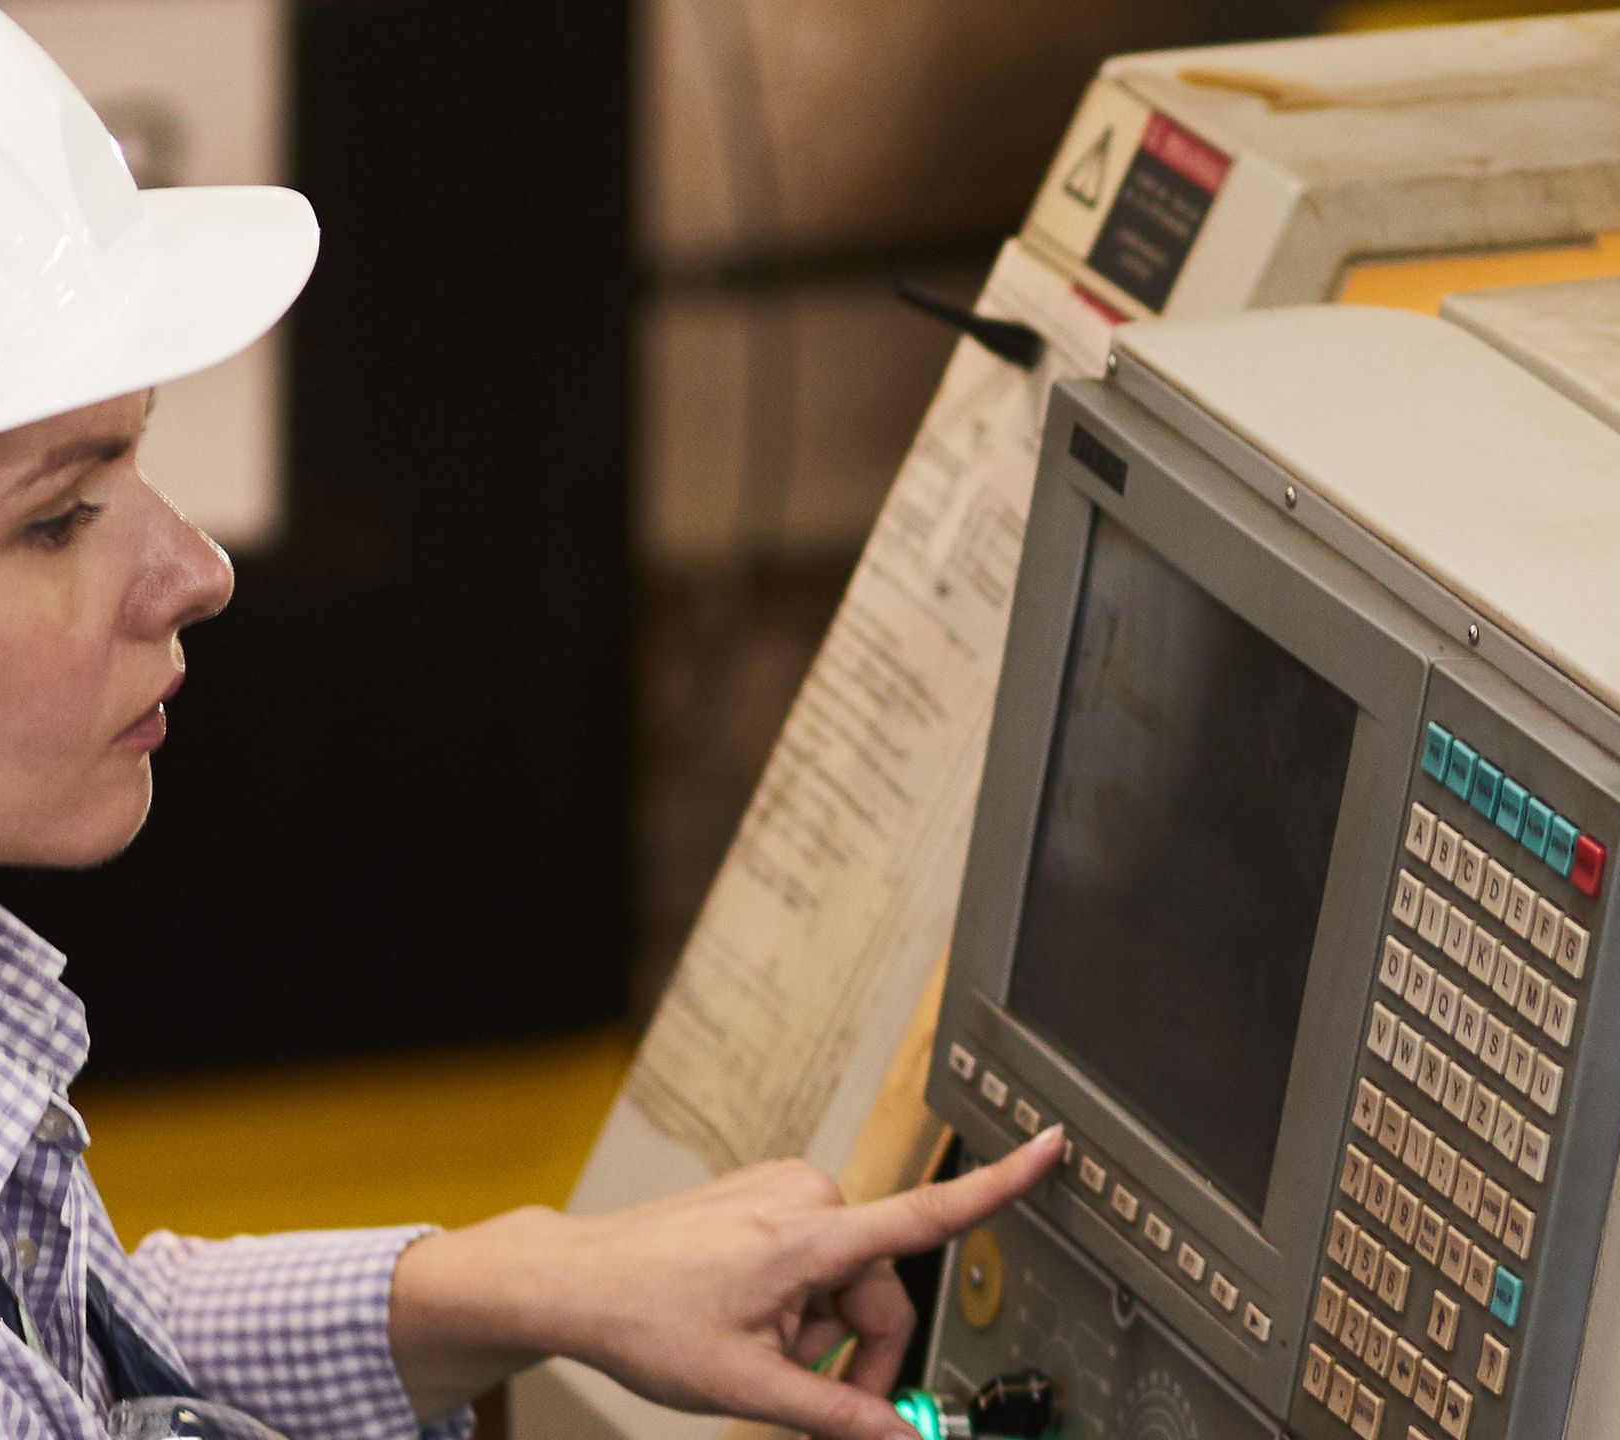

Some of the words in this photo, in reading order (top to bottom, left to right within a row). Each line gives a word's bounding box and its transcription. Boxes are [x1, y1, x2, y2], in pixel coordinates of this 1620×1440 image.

[1412, 821, 1423, 844] A
[1438, 838, 1449, 863] B
[1463, 859, 1475, 882] C
[1488, 877, 1500, 900] D
[1512, 896, 1524, 920] E
[1538, 915, 1551, 937] F
[1566, 934, 1579, 959] G
[1399, 885, 1413, 911] H
[1451, 926, 1462, 948] J
[1475, 942, 1488, 968] K
[1500, 962, 1509, 988] L
[1524, 982, 1538, 1009] M
[1550, 1003, 1564, 1028] N
[1376, 1018, 1387, 1043] V
[1399, 1037, 1414, 1064] W
[1424, 1058, 1437, 1084] X
[1452, 1078, 1463, 1102] Y
[1475, 1098, 1487, 1125] Z
[1387, 950, 1399, 976] O
[1411, 971, 1424, 994] P
[1437, 991, 1449, 1018] Q
[1462, 1012, 1474, 1037] R
[1488, 1032, 1499, 1055] S
[1514, 1051, 1525, 1074] T
[1538, 1071, 1550, 1095] U
[1348, 1155, 1361, 1182] 7
[1373, 1181, 1385, 1205] 8
[1398, 1201, 1409, 1225] 9
[1336, 1229, 1346, 1251] 4
[1360, 1246, 1372, 1270] 5
[1385, 1268, 1397, 1293] 6
[1350, 1314, 1361, 1341] 2
[1372, 1330, 1386, 1358] 3
